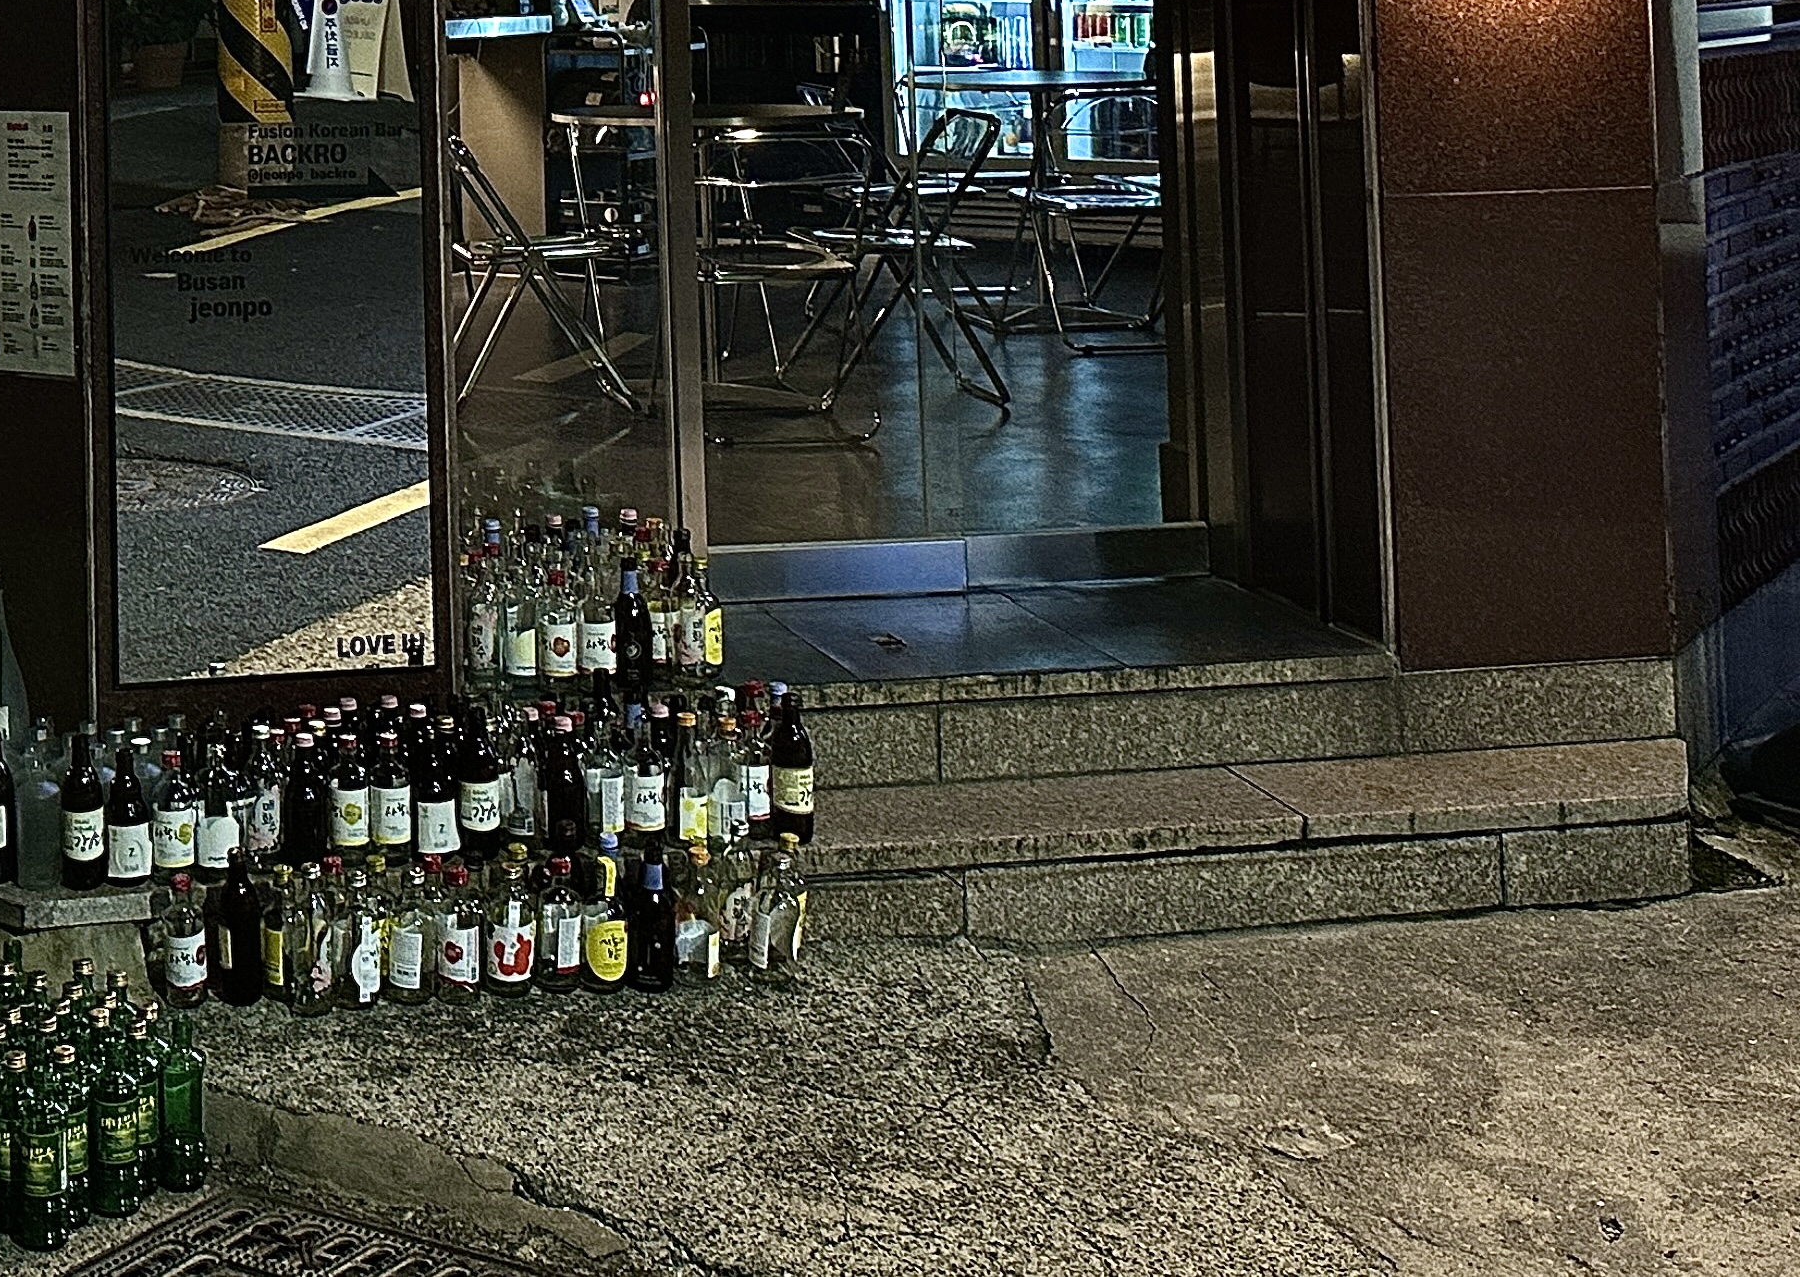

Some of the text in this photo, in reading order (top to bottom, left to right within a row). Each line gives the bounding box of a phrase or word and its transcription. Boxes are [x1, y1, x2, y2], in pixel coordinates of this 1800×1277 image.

[247, 122, 404, 140] Fusion Korean Bar
[247, 143, 348, 165] BACKRO
[130, 246, 252, 265] Welcome to
[177, 273, 246, 292] Busan
[188, 297, 273, 324] jeonpo
[336, 633, 397, 659] LOVE
